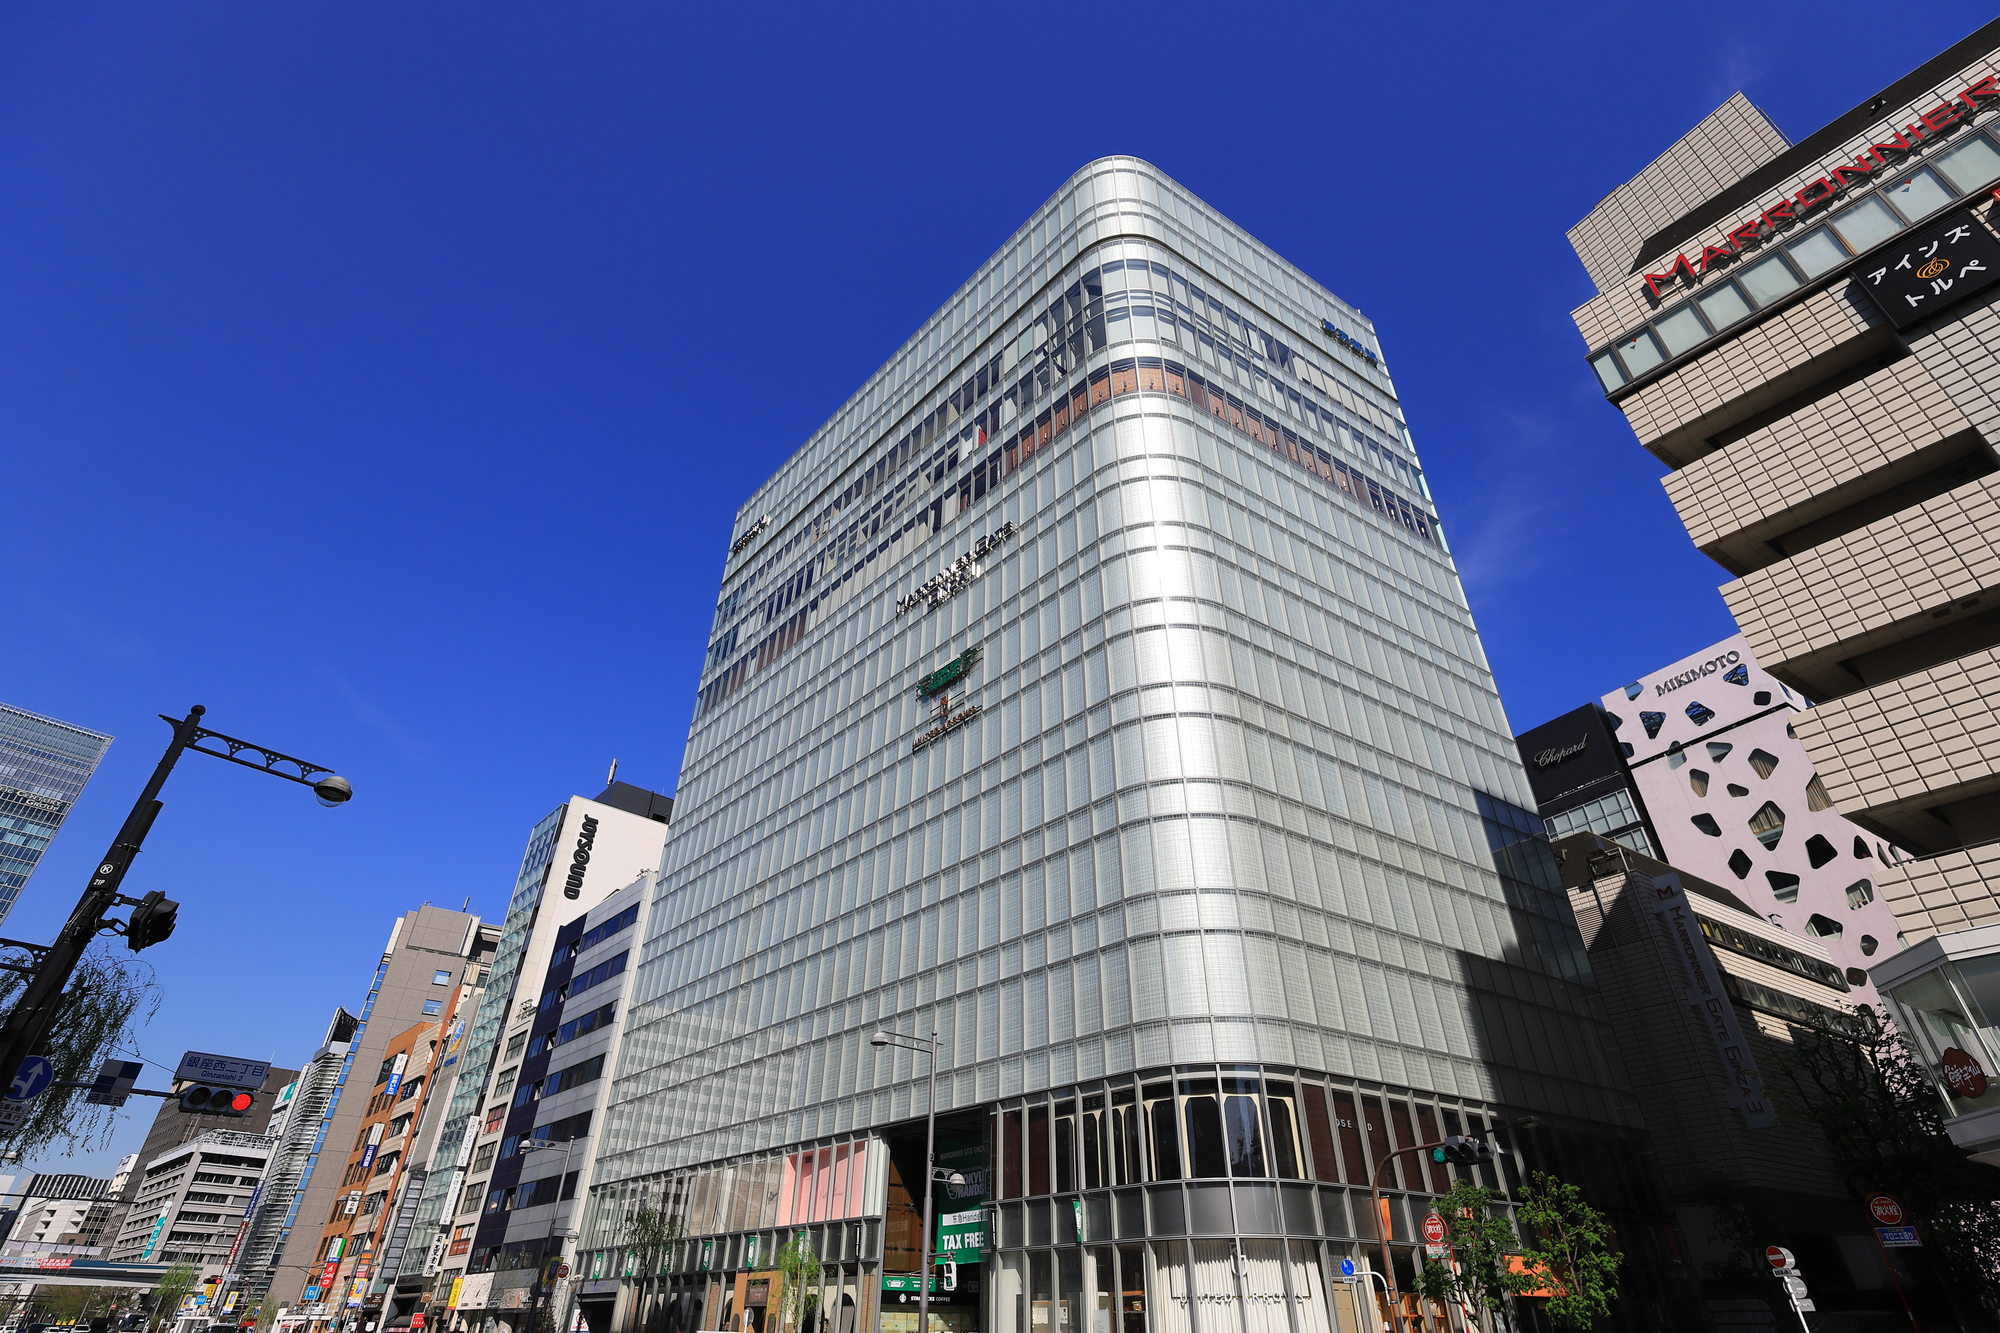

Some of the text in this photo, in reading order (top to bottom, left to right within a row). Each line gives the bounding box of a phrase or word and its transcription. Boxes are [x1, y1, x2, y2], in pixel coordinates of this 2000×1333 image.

[1644, 76, 2000, 296] MARRONNIER
[1867, 224, 1971, 285] アインズ
[1905, 260, 1987, 307] トルペ
[1655, 650, 1740, 698] MIKIMOTO
[912, 726, 940, 747] UNITED
[1534, 733, 1588, 767] Chopard
[17, 790, 62, 806] CENTURY
[26, 799, 59, 811] GROUP
[564, 814, 599, 901] JOYSOUND
[1669, 905, 1712, 995] MARRONNIER
[1706, 998, 1731, 1041] GATE
[1725, 1046, 1752, 1097] GINZA
[185, 1056, 265, 1077] 銀座西二丁目
[201, 1070, 237, 1081] Ginzanishi
[86, 1092, 124, 1106] 時差式
[964, 1147, 973, 1156] GATE
[963, 1170, 985, 1186] OKYU
[1873, 1205, 1899, 1216] 消火栓
[942, 1231, 984, 1250] TAX FREE
[1883, 1231, 1914, 1240] マロニエ通り
[1180, 1291, 1304, 1303] UITED RROS
